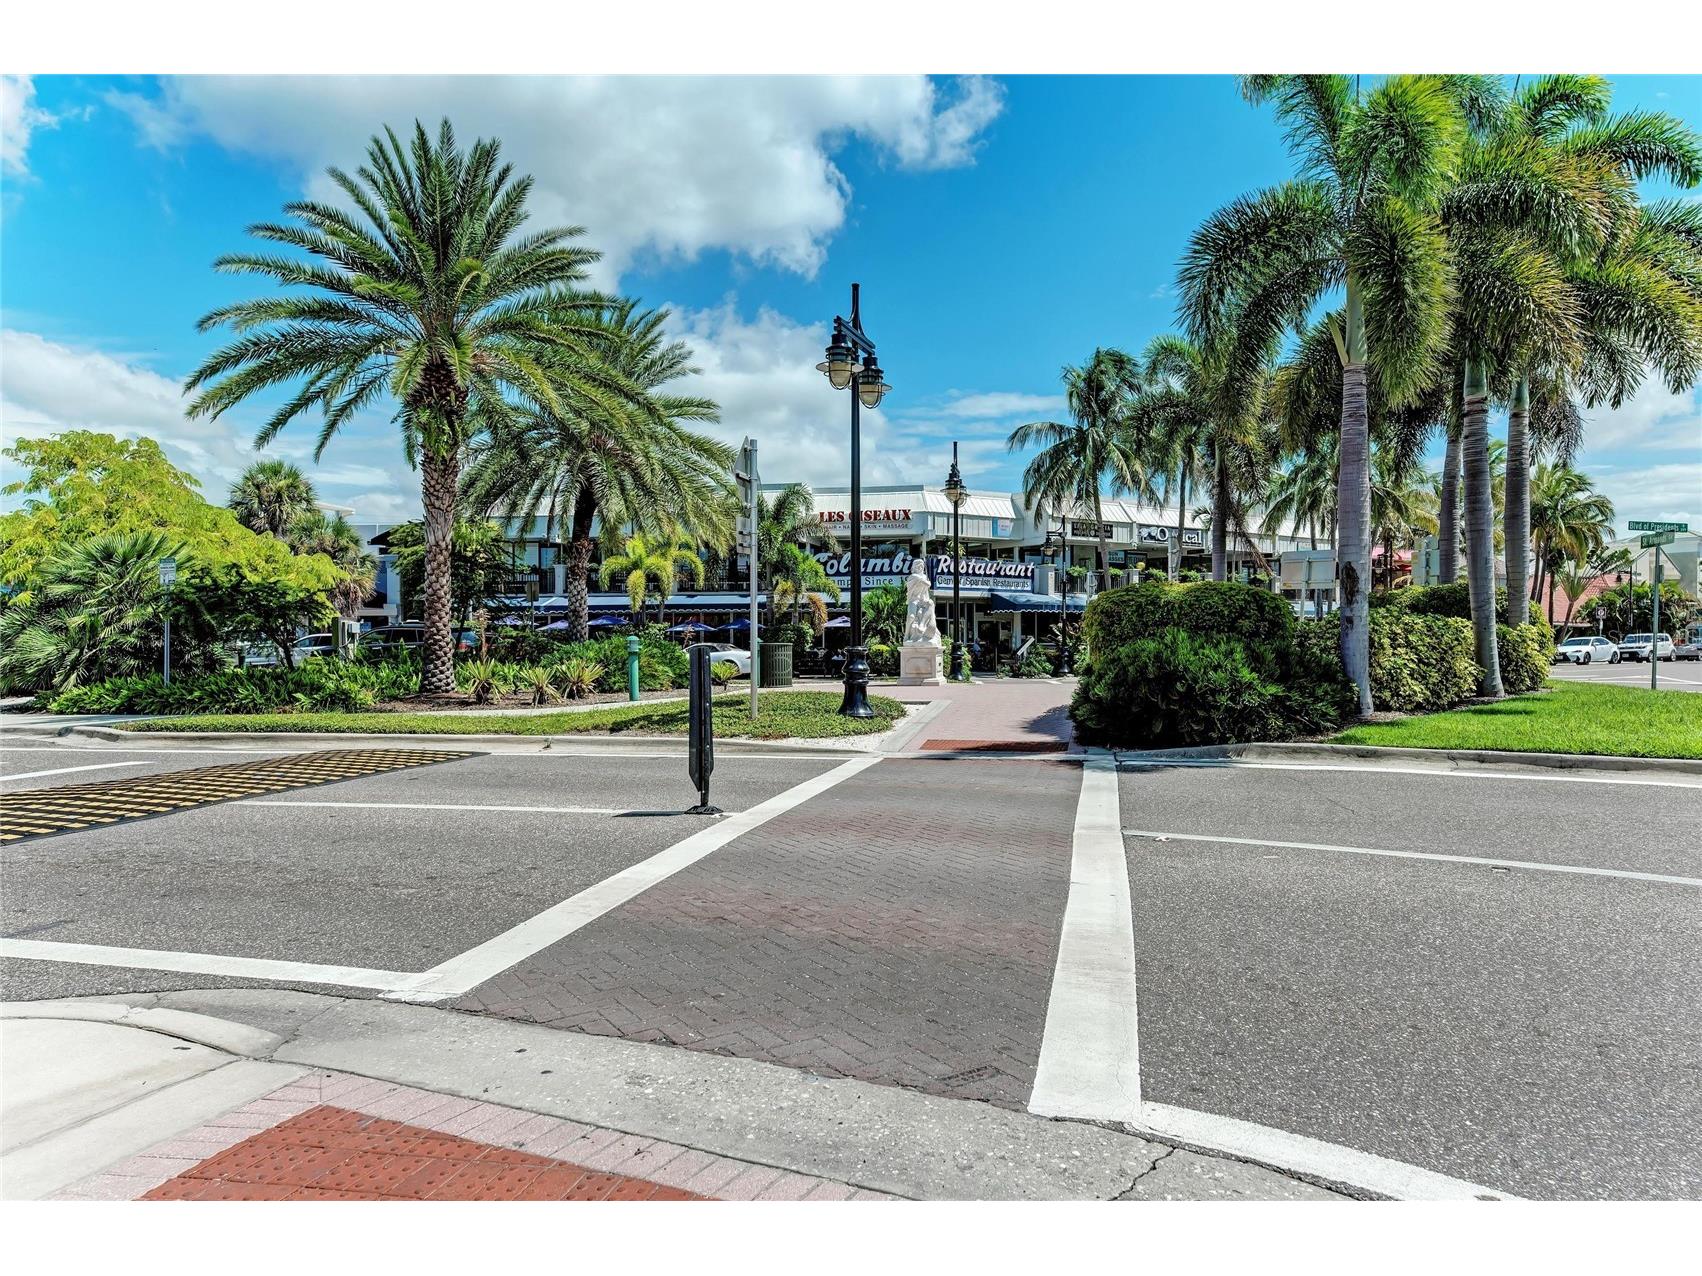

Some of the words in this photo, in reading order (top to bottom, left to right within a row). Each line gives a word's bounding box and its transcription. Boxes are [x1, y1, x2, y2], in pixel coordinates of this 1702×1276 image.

[819, 511, 845, 522] LES
[849, 509, 911, 522] ISEAUX
[1629, 522, 1643, 530] Blvd
[1651, 523, 1680, 532] Presidents
[1157, 527, 1202, 543] Oical
[814, 552, 912, 575] Colmbi
[865, 576, 893, 586] Since
[965, 576, 991, 588] Spanish
[993, 578, 1030, 589] Restaurants
